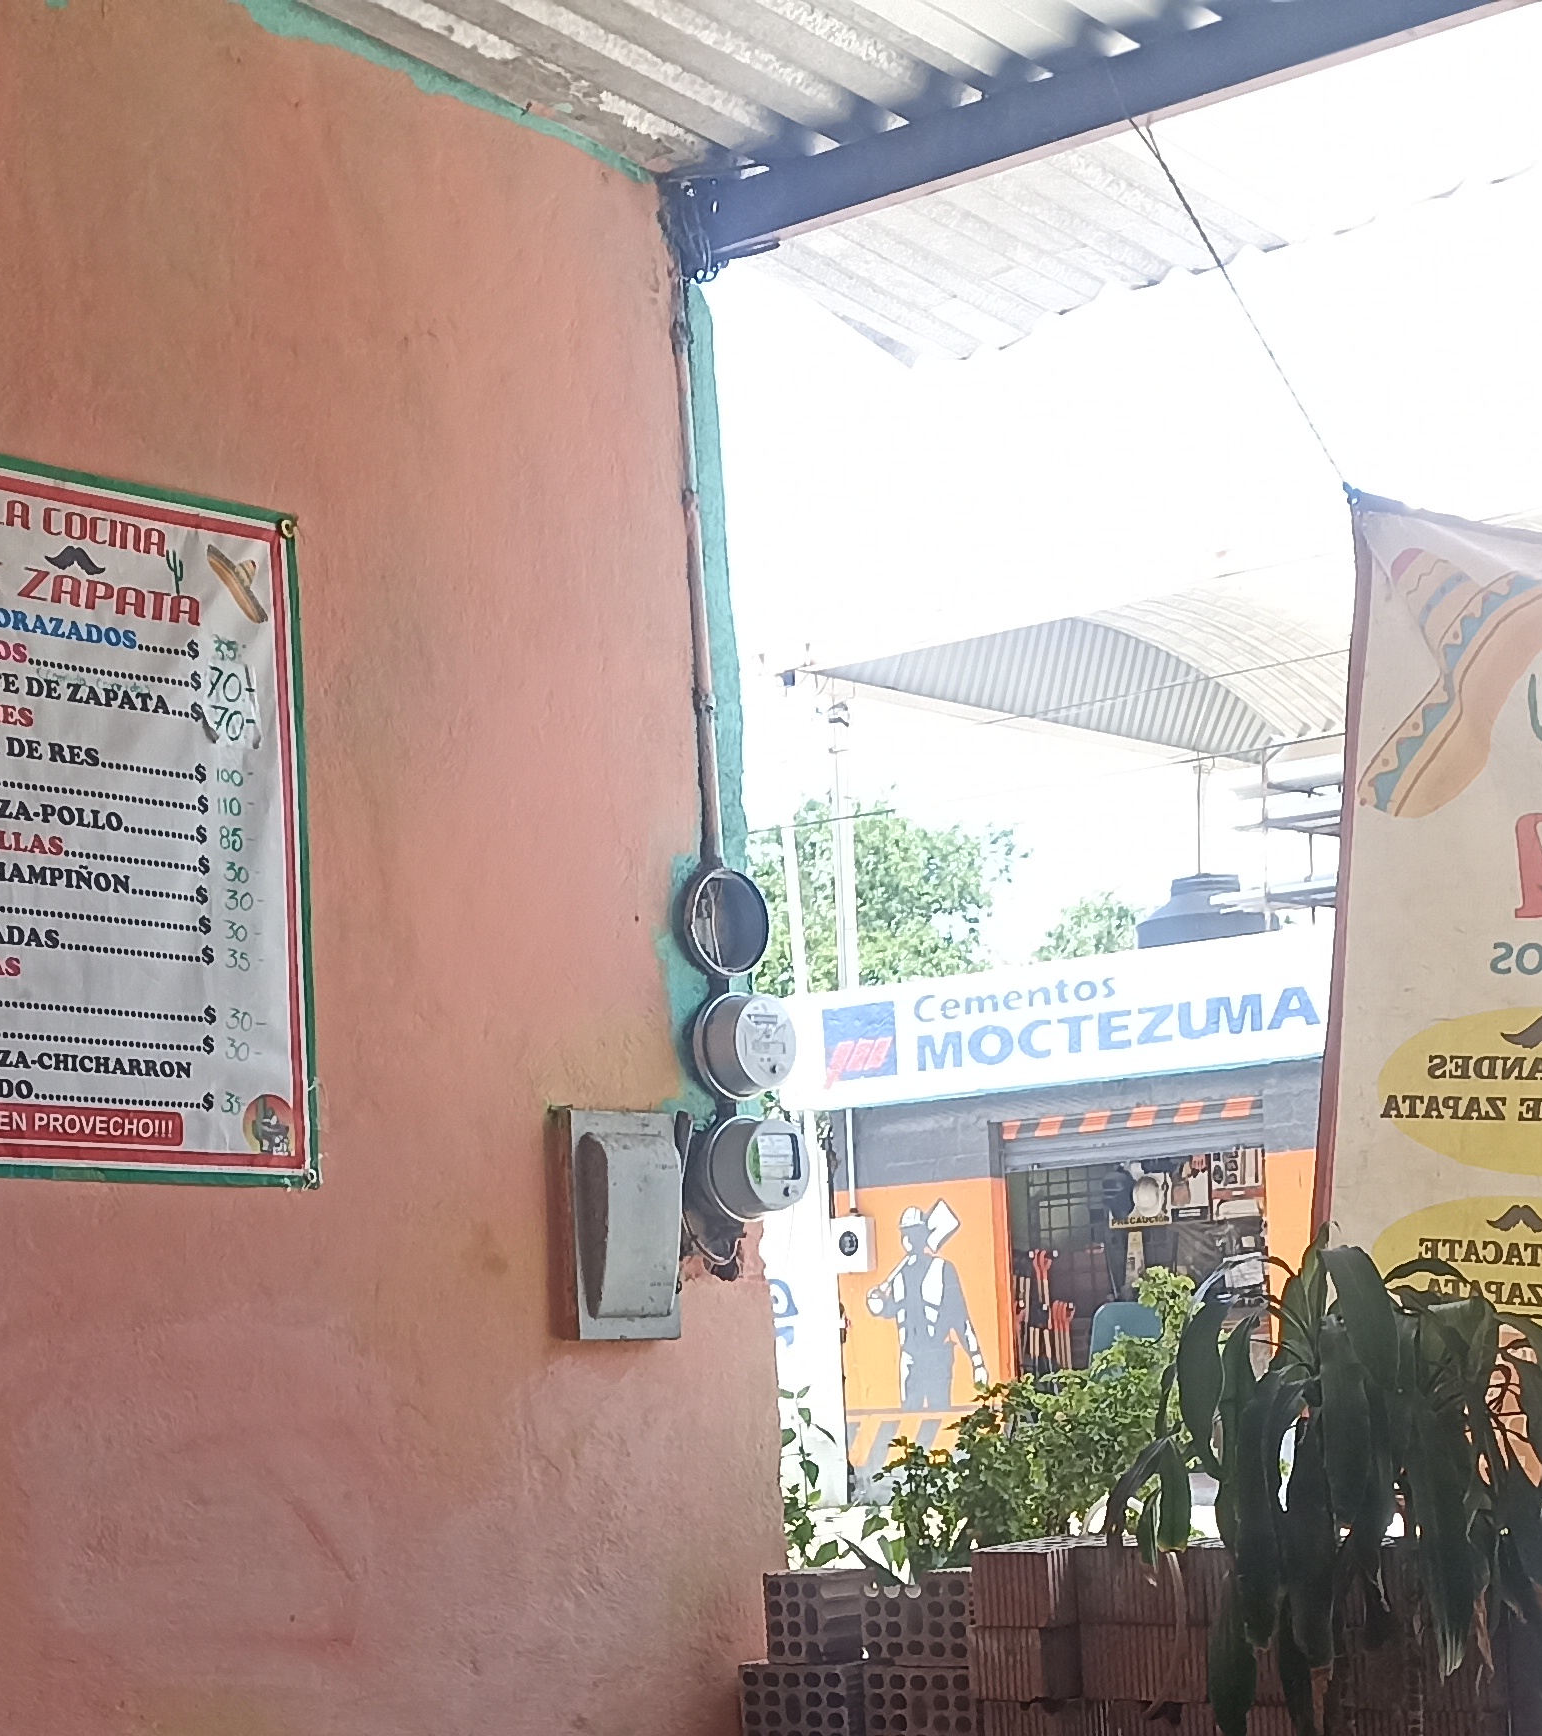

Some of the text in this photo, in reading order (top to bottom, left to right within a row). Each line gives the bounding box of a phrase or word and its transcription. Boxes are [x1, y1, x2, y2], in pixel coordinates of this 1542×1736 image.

[42, 507, 166, 558] COCINA
[19, 567, 201, 626] ZAPATA
[25, 676, 61, 700] DE
[66, 683, 170, 715] ZAPATA
[6, 737, 43, 761] DE
[48, 742, 100, 767] RES
[913, 972, 1117, 1023] Cementos
[916, 984, 1320, 1072] MOCTEZUMA
[33, 1113, 174, 1139] PROVECHO!!!
